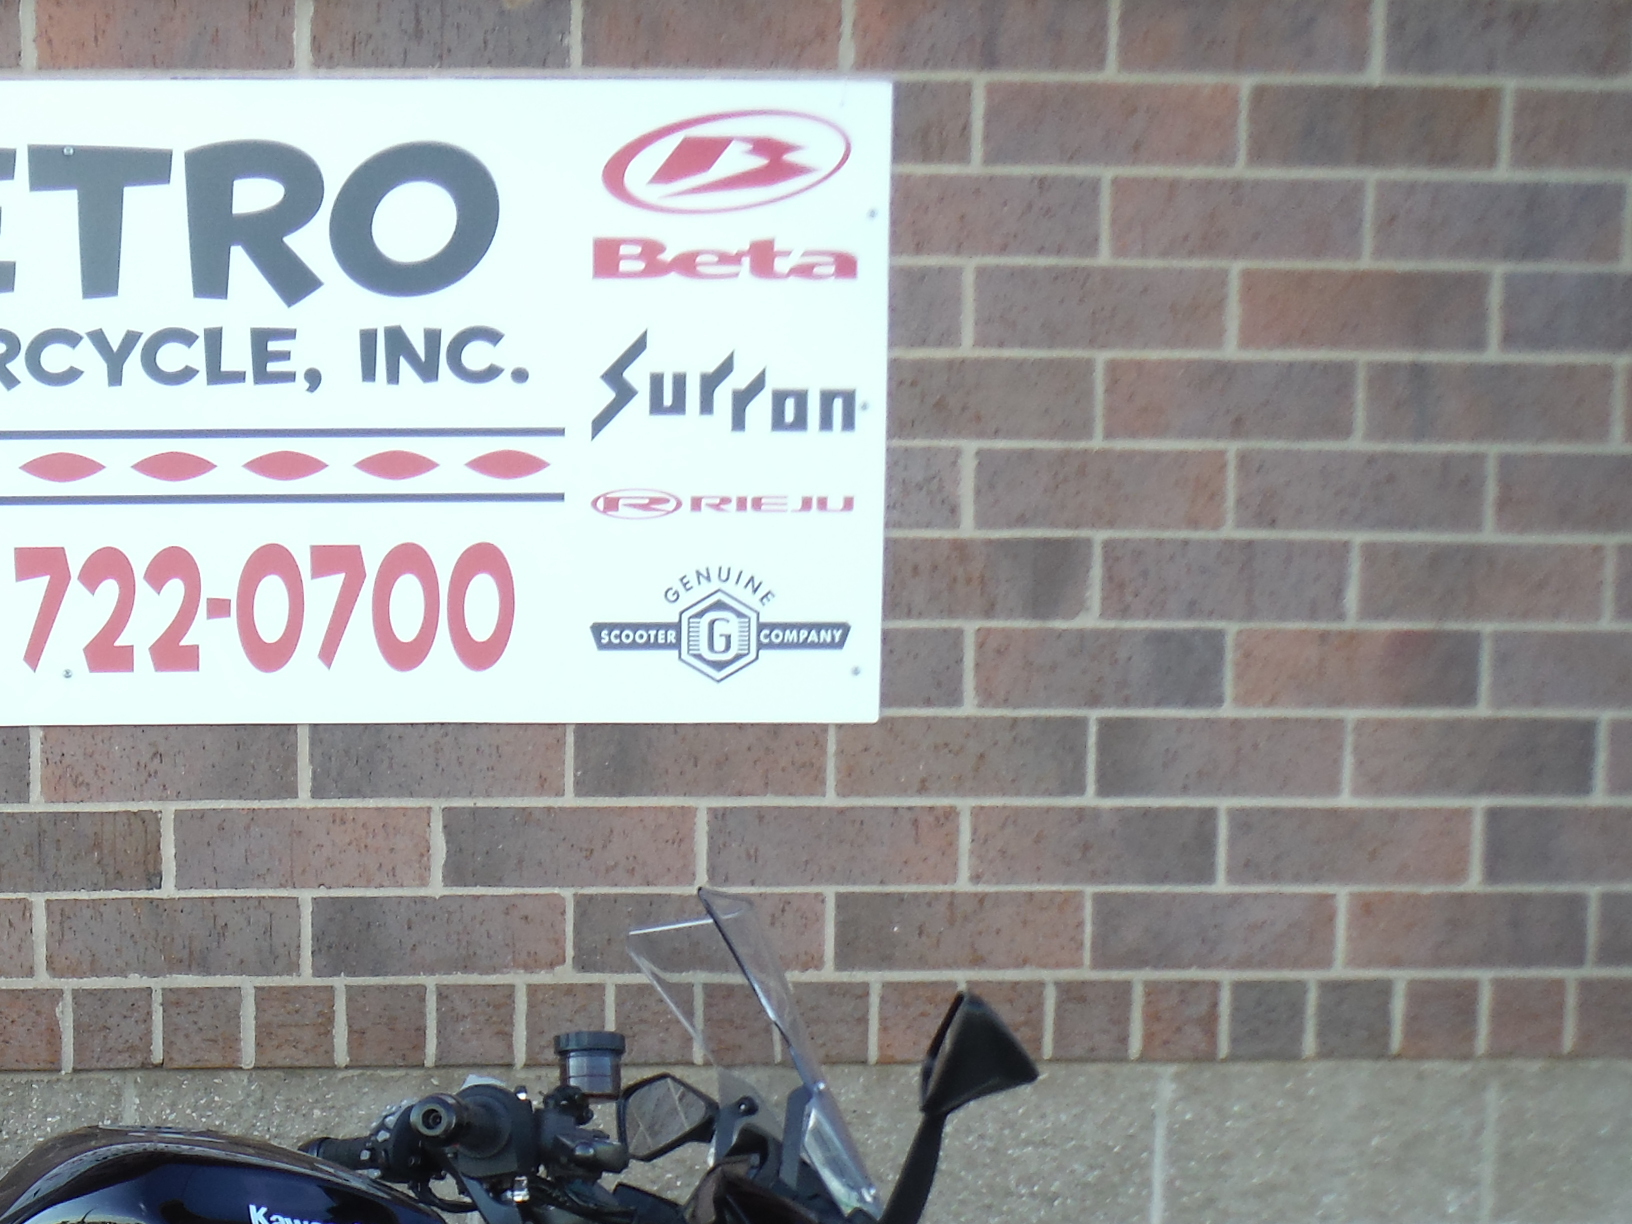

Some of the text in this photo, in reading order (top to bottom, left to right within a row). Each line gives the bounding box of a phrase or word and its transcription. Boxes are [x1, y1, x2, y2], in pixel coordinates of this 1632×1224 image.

[592, 236, 858, 280] Beta
[359, 325, 530, 386] INC.
[591, 328, 856, 441] Surron
[690, 495, 855, 513] RIEJU
[13, 541, 516, 674] 722-0700
[664, 566, 775, 607] GENUINE
[600, 629, 677, 645] SCOOTER
[759, 628, 843, 644] COMPANY
